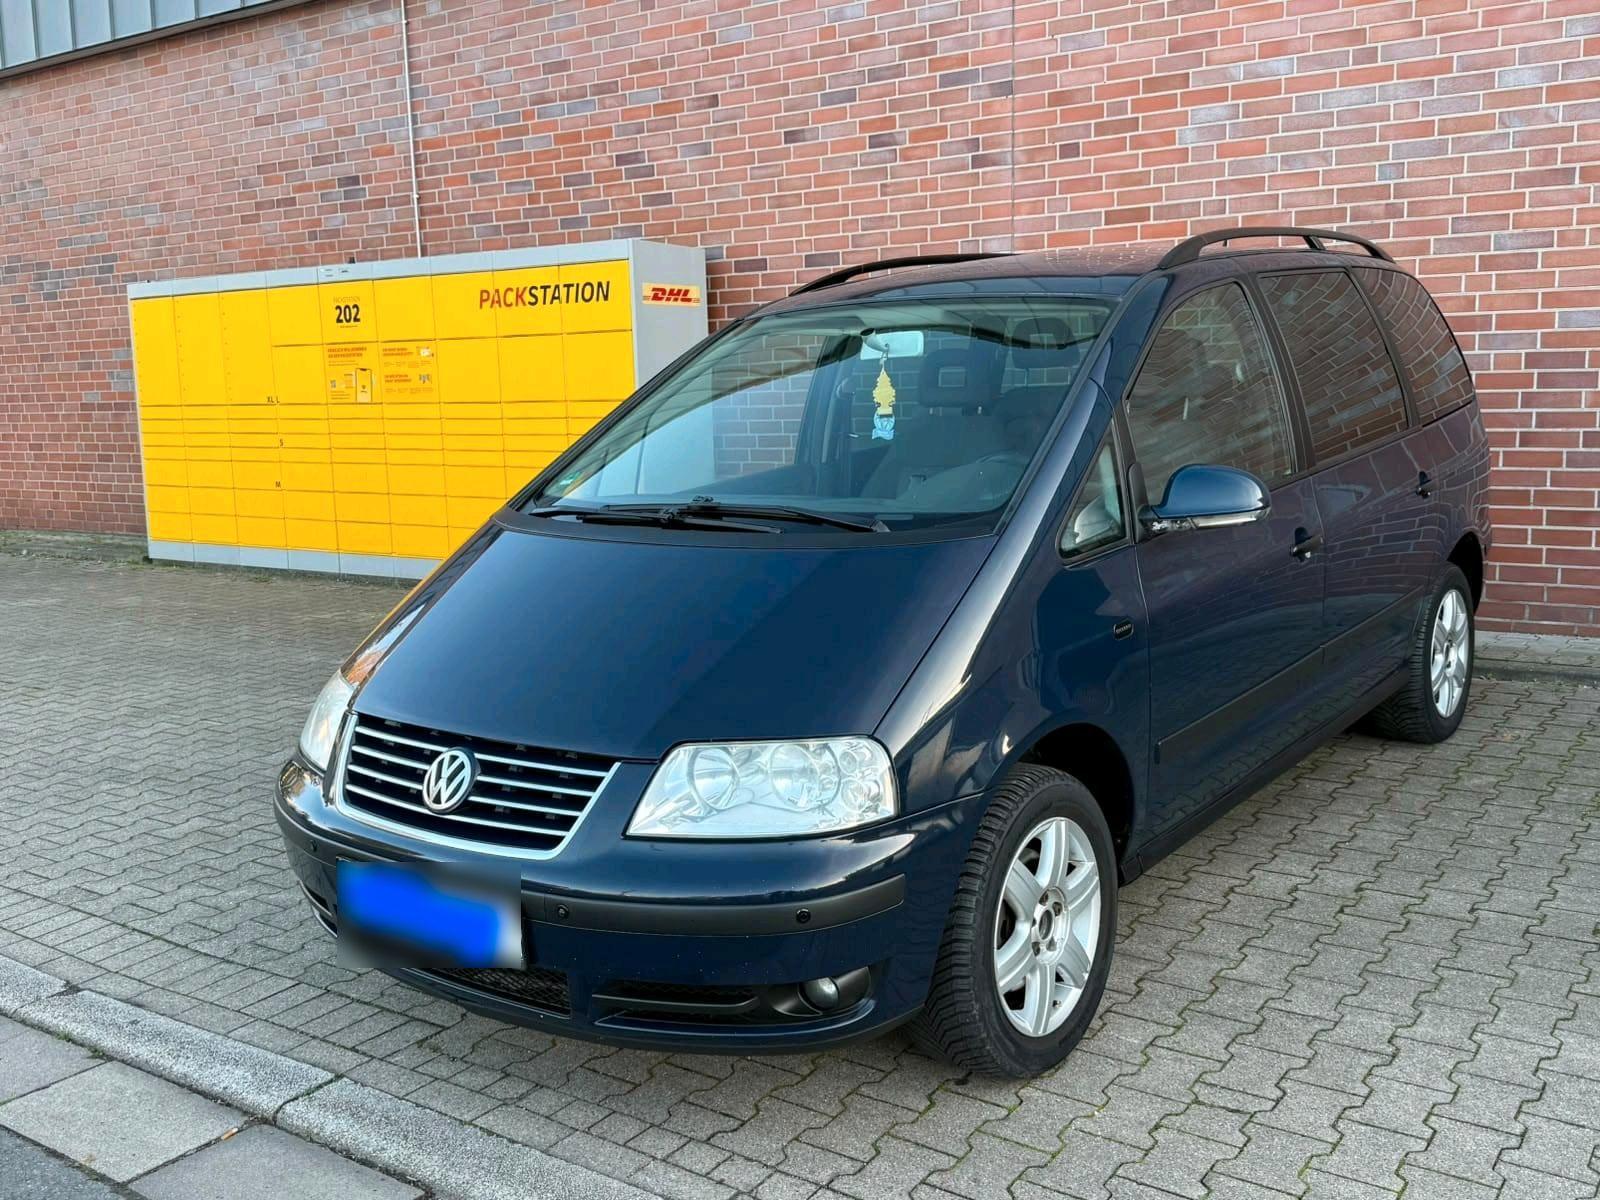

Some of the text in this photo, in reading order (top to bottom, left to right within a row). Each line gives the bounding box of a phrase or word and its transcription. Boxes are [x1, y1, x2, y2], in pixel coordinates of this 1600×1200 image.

[479, 281, 610, 309] PACKSTATION
[651, 287, 693, 303] DHL
[335, 304, 361, 323] 202
